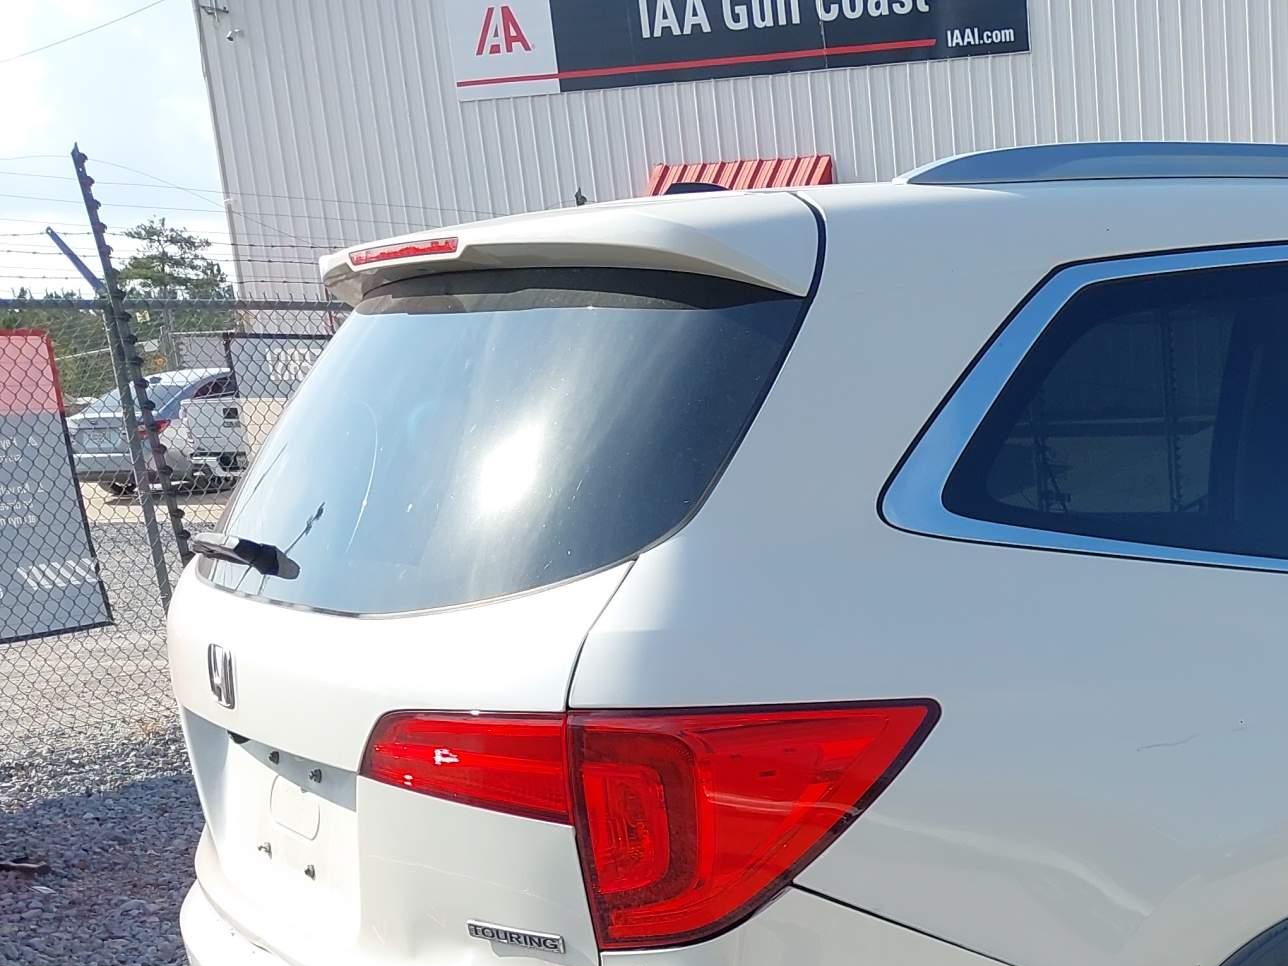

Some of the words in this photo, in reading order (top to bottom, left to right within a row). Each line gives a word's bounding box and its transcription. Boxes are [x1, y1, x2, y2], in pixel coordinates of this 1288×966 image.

[638, 0, 712, 38] IAA
[946, 27, 1015, 48] IAAI.com
[471, 925, 559, 950] TOURING
